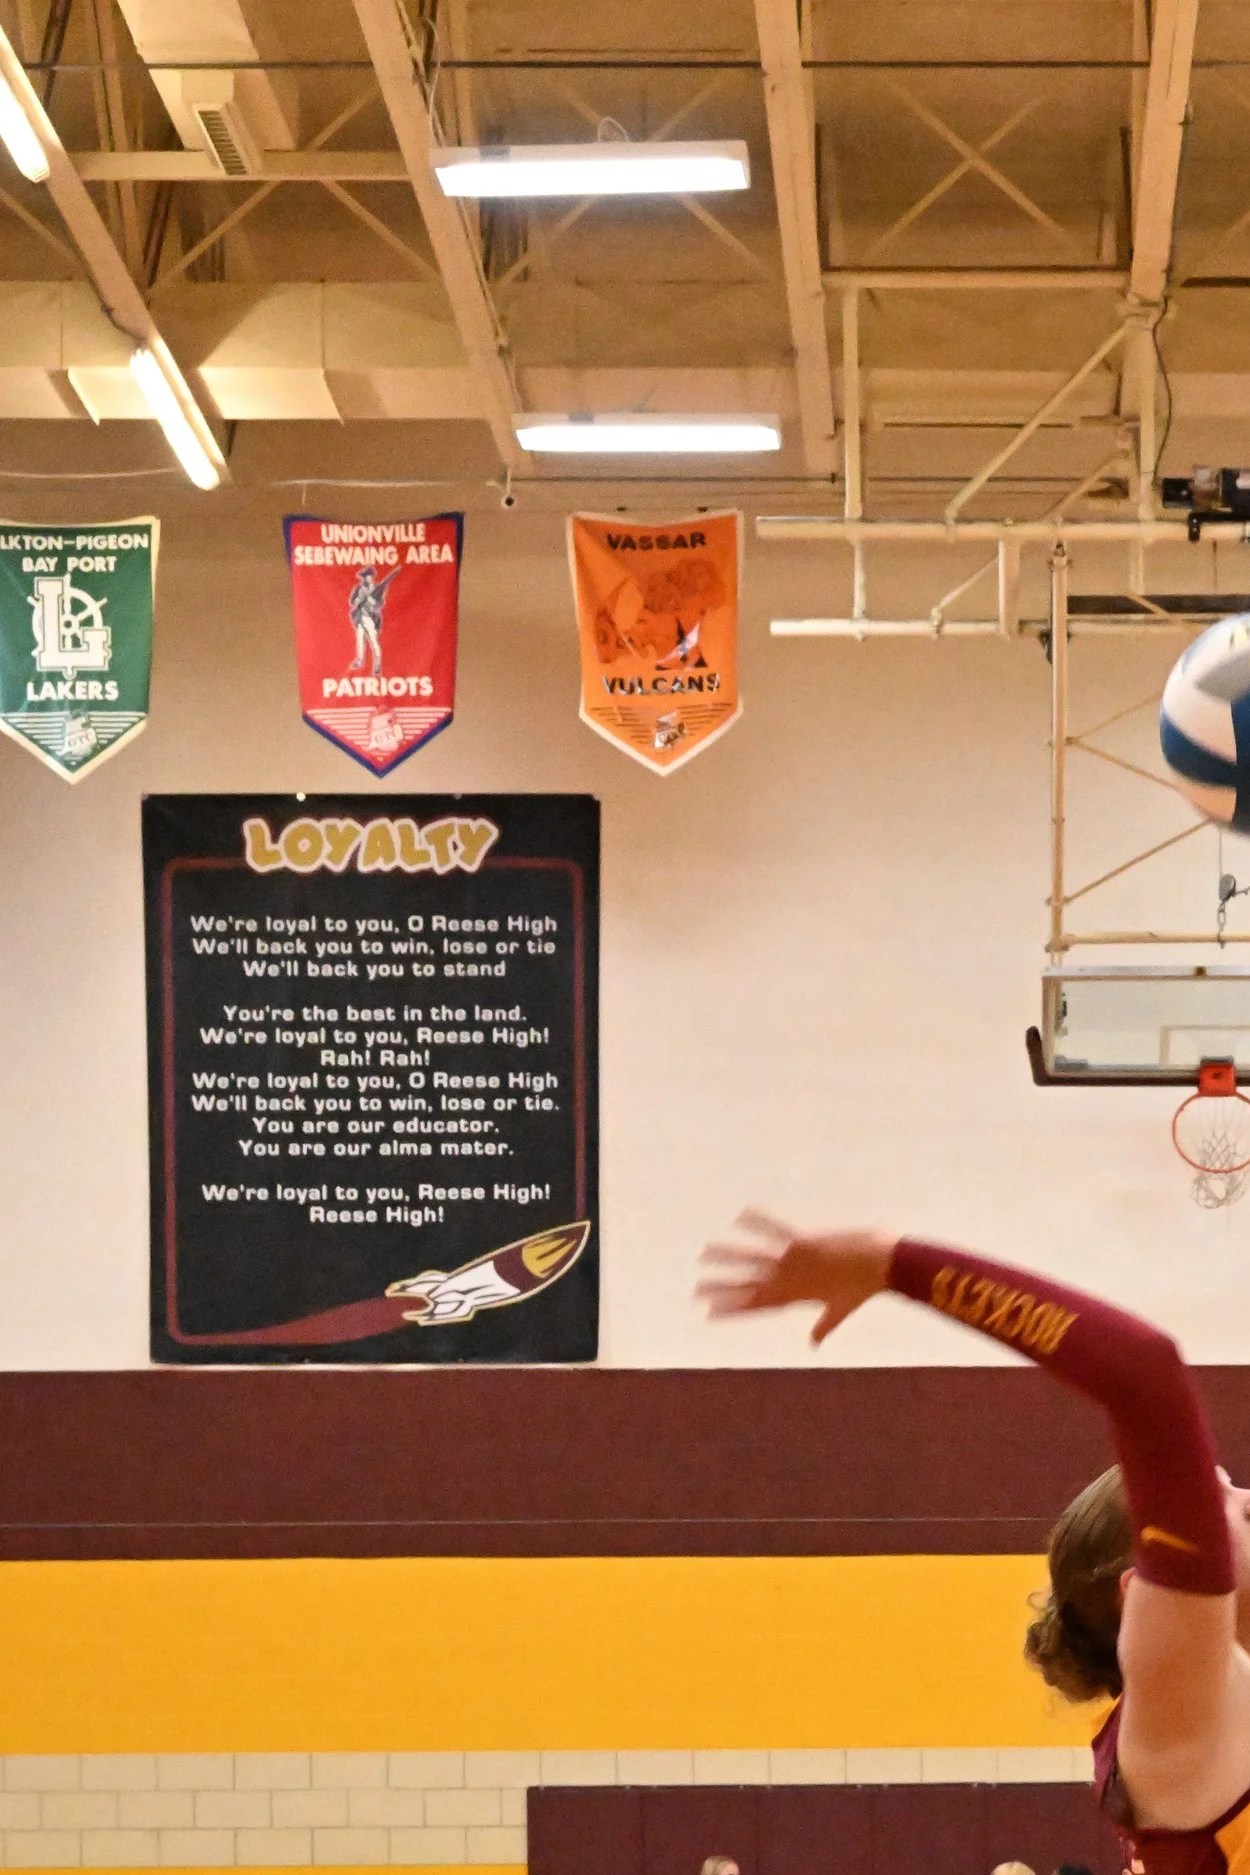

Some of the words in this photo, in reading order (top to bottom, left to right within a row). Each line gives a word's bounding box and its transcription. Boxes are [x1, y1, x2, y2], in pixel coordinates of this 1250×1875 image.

[320, 523, 426, 543] UNIONVILLE
[606, 531, 707, 551] VASSAR
[22, 556, 58, 573] BAY
[67, 556, 117, 573] PORT
[293, 545, 399, 565] SEBEWAING
[405, 544, 454, 564] AREA
[26, 681, 120, 701] LAKERS
[322, 676, 433, 698] PATRIOTS
[602, 673, 721, 695] VULCANS
[242, 816, 500, 875] LOYALTY
[190, 915, 258, 933] We're
[265, 915, 317, 936] loyal
[324, 917, 348, 933] to
[407, 914, 424, 933] O
[431, 914, 500, 933] Reese
[507, 915, 558, 937] High
[192, 937, 249, 955] We'll
[255, 937, 308, 955] back
[314, 941, 353, 959] you
[360, 939, 384, 955] to
[442, 937, 488, 955] lose
[495, 941, 520, 955] or
[526, 937, 556, 955] tie
[242, 959, 299, 977] We'll
[306, 959, 359, 977] back
[365, 963, 405, 981] you
[411, 961, 436, 977] to
[443, 959, 507, 977] stand
[222, 1004, 295, 1023] You're
[301, 1004, 339, 1022] the
[346, 1004, 397, 1022] best
[403, 1004, 423, 1022] in
[429, 1004, 467, 1022] the
[474, 1004, 527, 1022] land.
[199, 1027, 268, 1045] We're
[274, 1026, 326, 1048] loyal
[333, 1028, 357, 1045] to
[363, 1030, 409, 1048] you,
[416, 1026, 485, 1044] Reese
[492, 1026, 549, 1049] High!
[320, 1049, 371, 1067] Rah!
[379, 1048, 430, 1067] Rah!
[191, 1071, 260, 1090] We're
[267, 1071, 319, 1093] loyal
[325, 1073, 350, 1089] to
[356, 1075, 402, 1093] you,
[408, 1071, 426, 1090] O
[432, 1071, 501, 1089] Reese
[508, 1071, 559, 1093] High
[191, 1094, 248, 1112] We'll
[254, 1094, 307, 1112] back
[313, 1098, 352, 1116] you
[358, 1096, 383, 1112] to
[388, 1094, 433, 1113] win,
[440, 1094, 486, 1111] lose
[492, 1097, 518, 1112] or
[524, 1094, 560, 1111] tie.
[251, 1116, 295, 1134] You
[301, 1120, 340, 1134] are
[346, 1120, 386, 1134] our
[392, 1116, 500, 1134] educator.
[237, 1139, 280, 1157] You
[287, 1142, 327, 1157] are
[333, 1142, 372, 1157] our
[378, 1139, 433, 1156] alma
[440, 1140, 514, 1156] mater.
[201, 1183, 269, 1202] We're
[276, 1183, 328, 1205] loyal
[334, 1185, 359, 1201] to
[365, 1187, 410, 1205] you,
[418, 1183, 486, 1201] Reese
[493, 1183, 551, 1205] High!
[309, 1205, 378, 1224] Reese
[385, 1205, 444, 1228] High!
